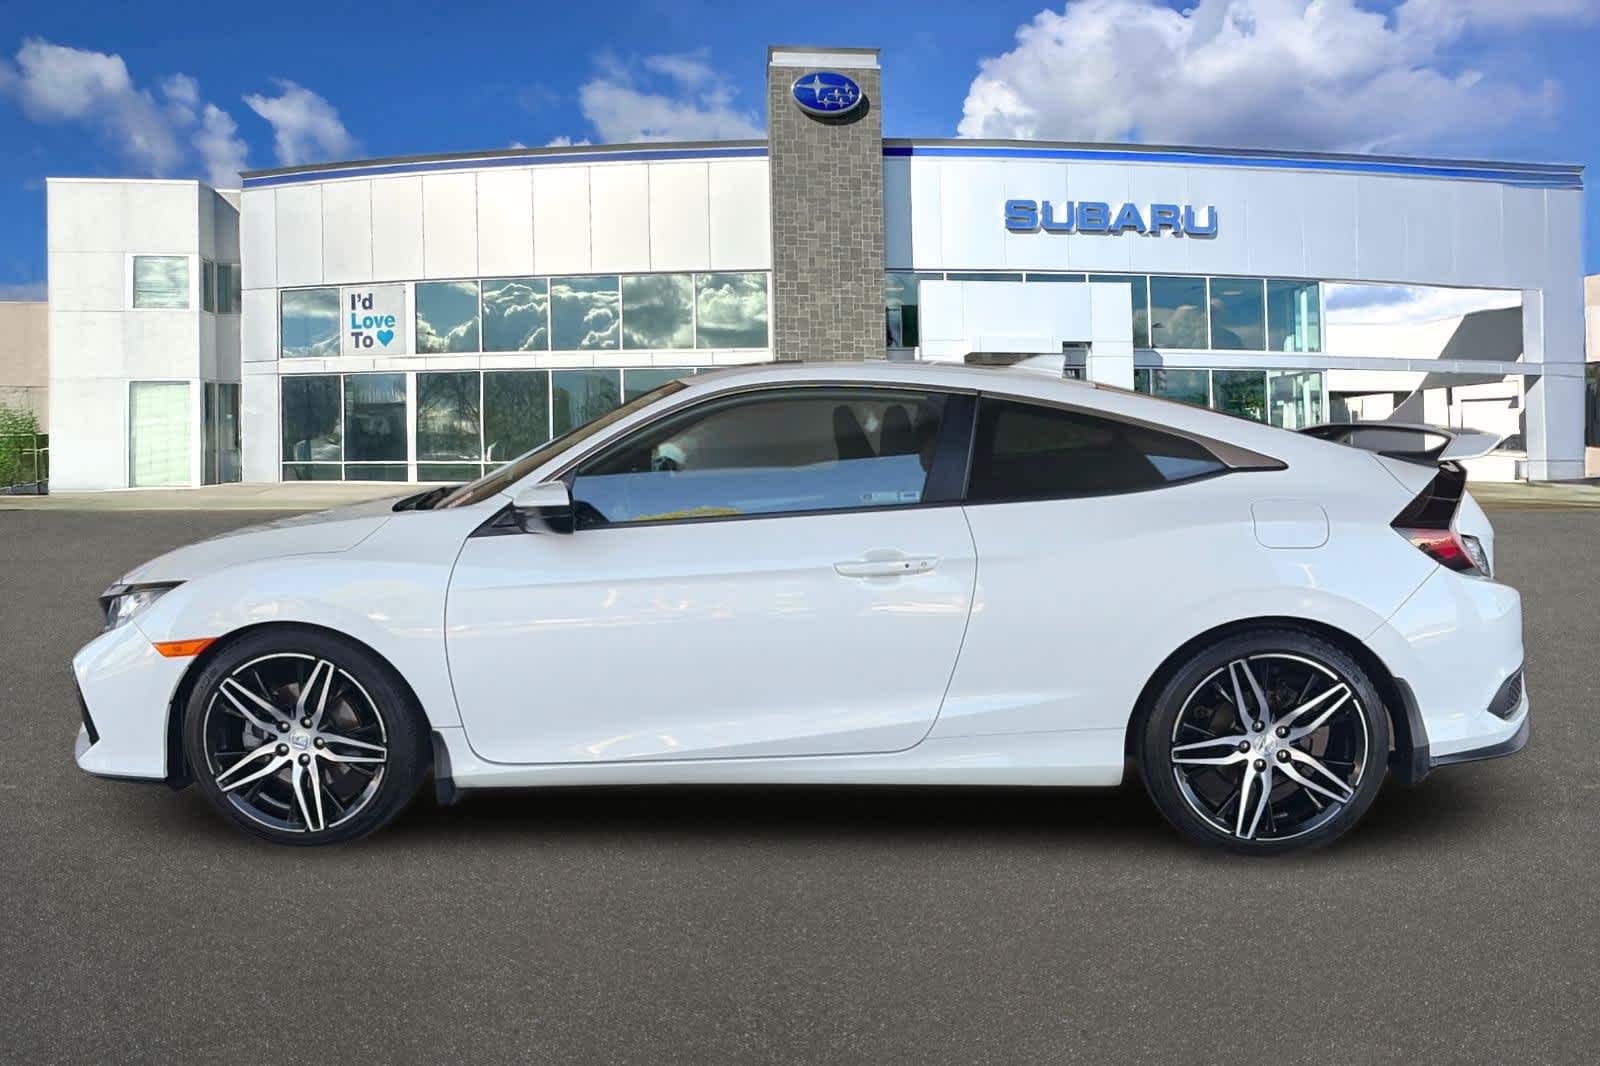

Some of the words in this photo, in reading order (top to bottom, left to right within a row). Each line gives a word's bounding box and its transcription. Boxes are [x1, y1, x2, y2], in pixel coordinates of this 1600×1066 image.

[1004, 199, 1218, 239] SUBARU
[351, 293, 373, 311] I'd
[351, 312, 396, 330] Love
[351, 331, 374, 349] To
